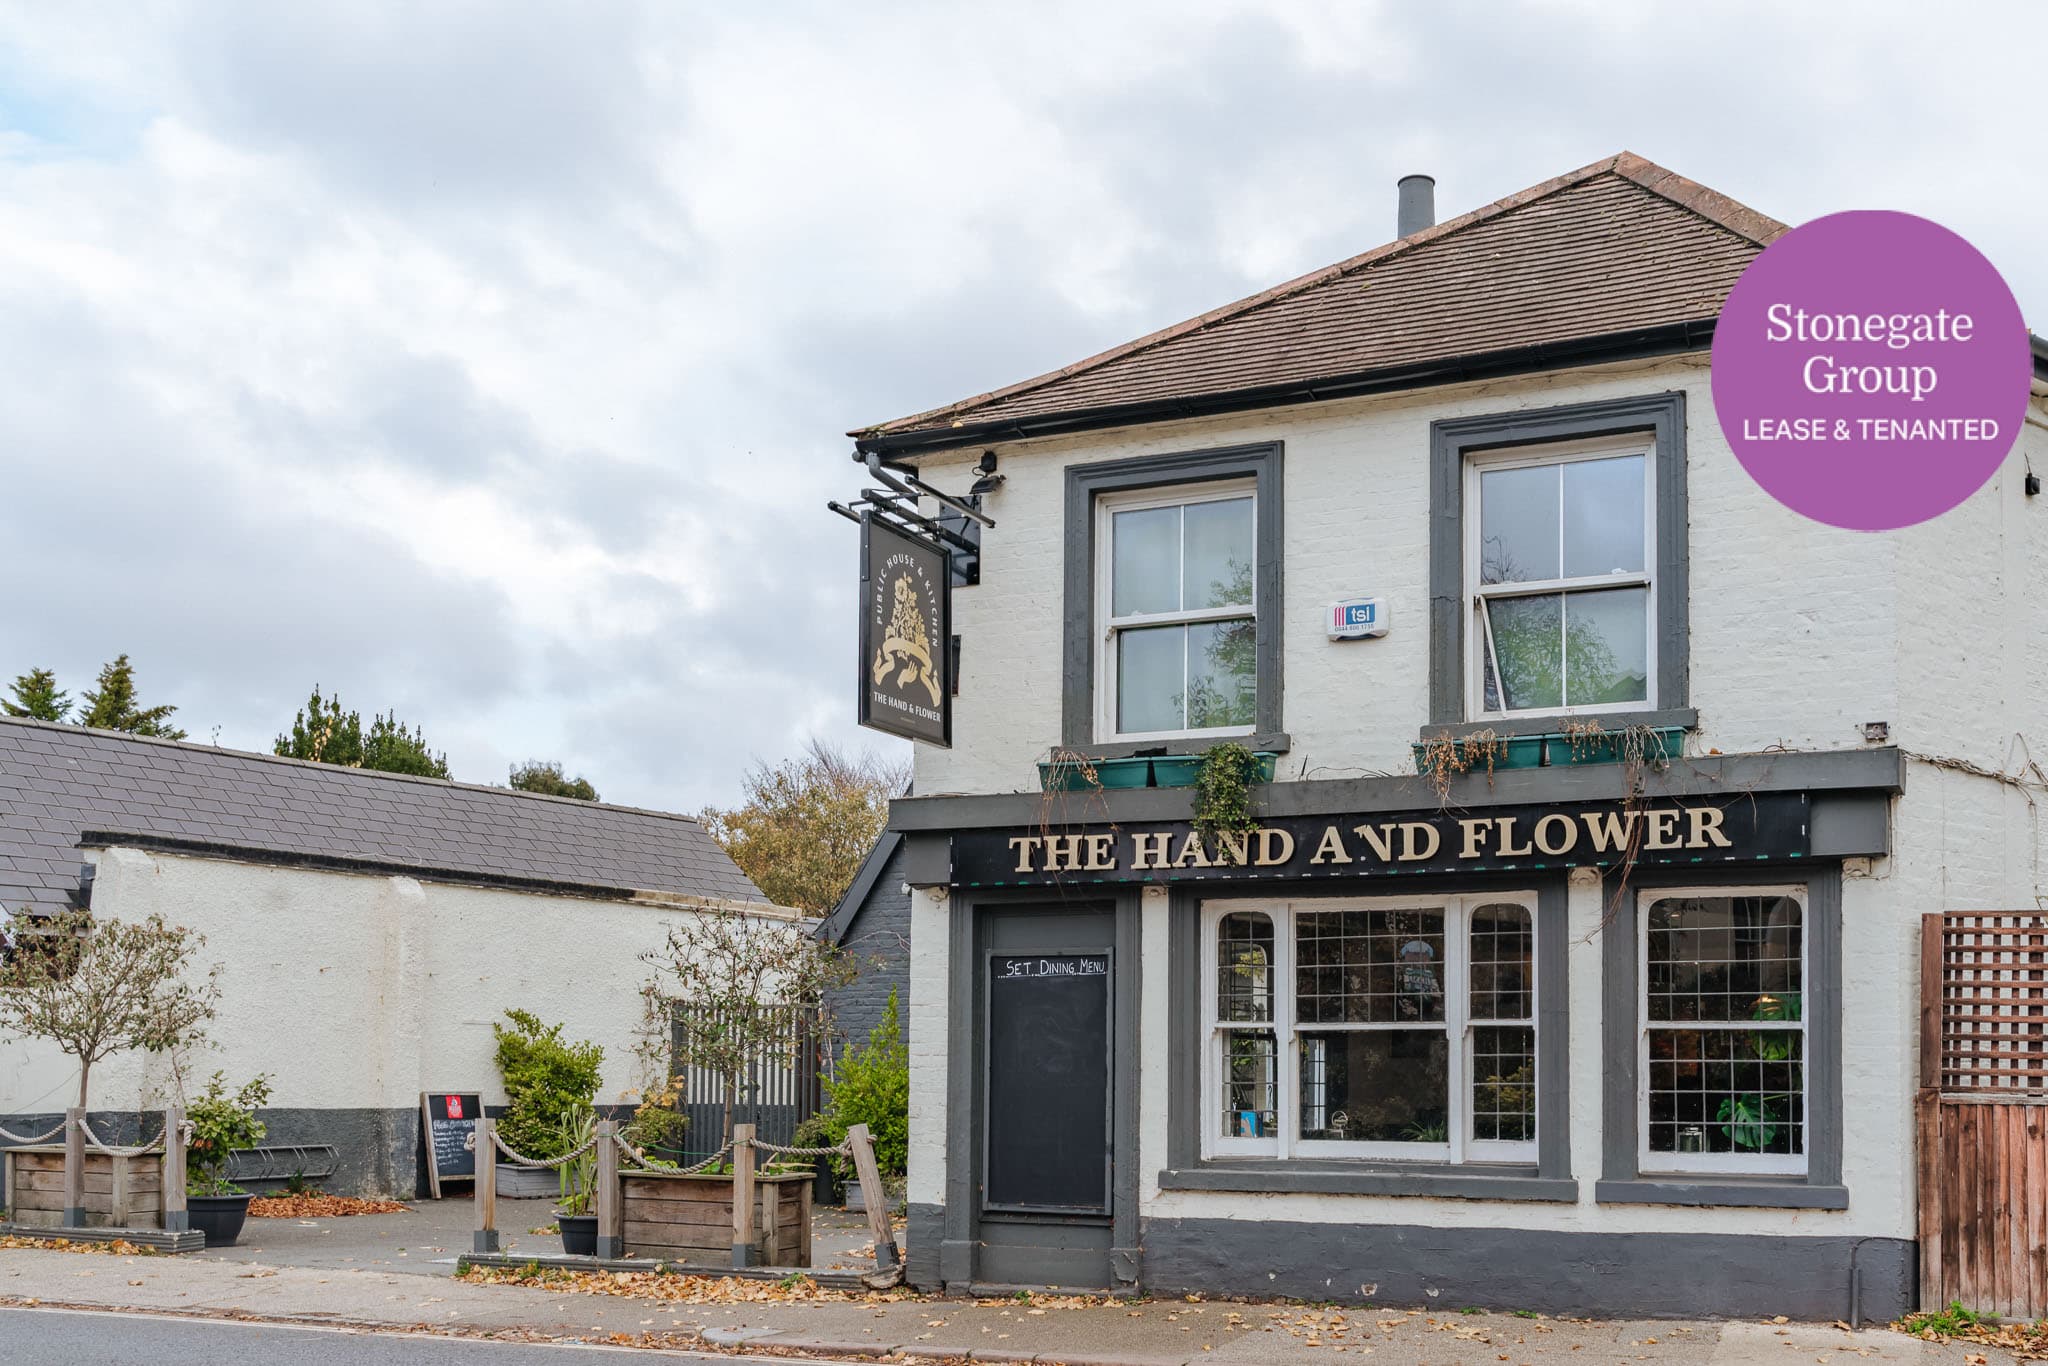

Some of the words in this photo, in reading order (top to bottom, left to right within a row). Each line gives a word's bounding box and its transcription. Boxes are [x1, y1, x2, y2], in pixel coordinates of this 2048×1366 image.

[876, 568, 887, 625] PUBLIC
[886, 553, 914, 569] HOUSE
[917, 566, 923, 577] &
[924, 580, 938, 647] KITCHEN
[873, 691, 887, 705] THE
[888, 696, 908, 711] HAND
[909, 703, 914, 714] &
[915, 705, 941, 722] FLOWER
[1008, 833, 1117, 872] THE
[1130, 828, 1295, 870] HAND
[1310, 822, 1441, 864] AND
[1458, 806, 1732, 858] FLOWER
[1006, 960, 1032, 976] SET
[1040, 959, 1075, 975] DINING
[1080, 958, 1105, 973] MENU
